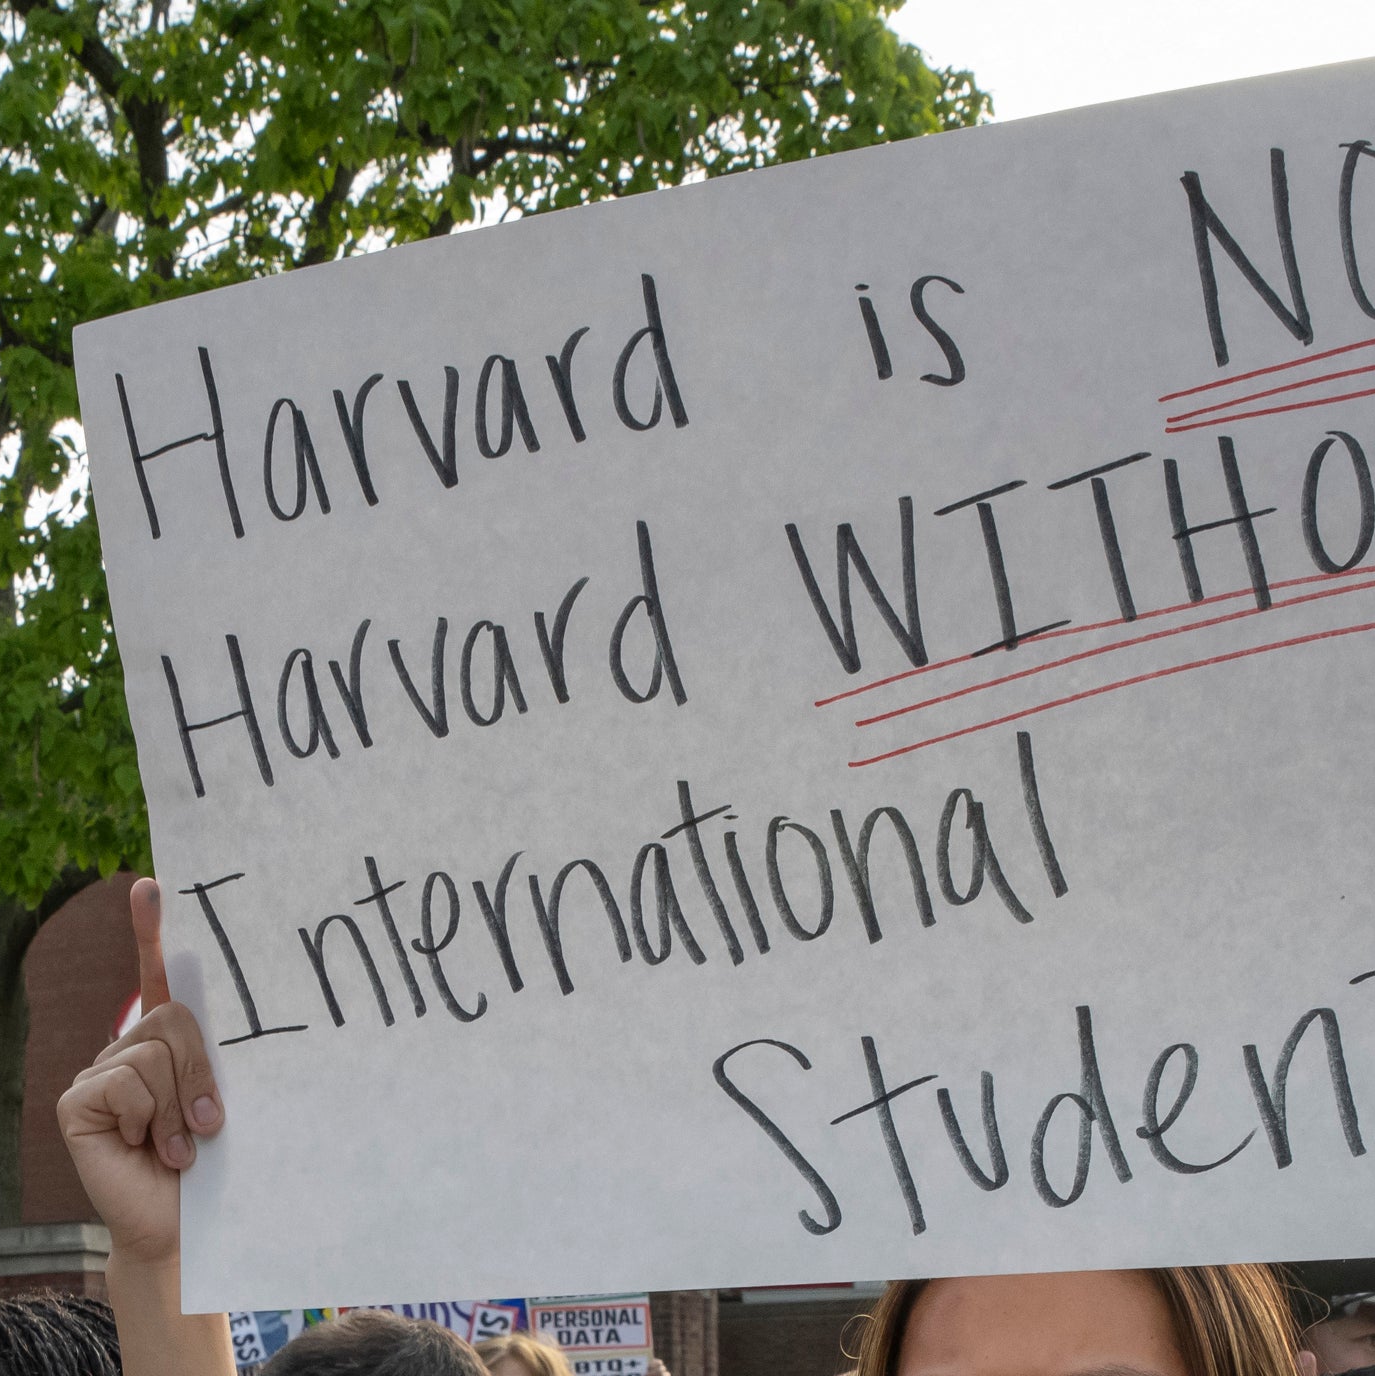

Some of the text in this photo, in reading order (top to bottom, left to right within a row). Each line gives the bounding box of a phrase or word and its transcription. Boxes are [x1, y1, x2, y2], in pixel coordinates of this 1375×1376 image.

[113, 272, 691, 541] Harvard
[853, 274, 967, 388] is
[160, 518, 690, 800] Harvard
[176, 729, 1070, 1049] International
[541, 1308, 642, 1329] PERSONAL
[559, 1328, 622, 1346] DATA
